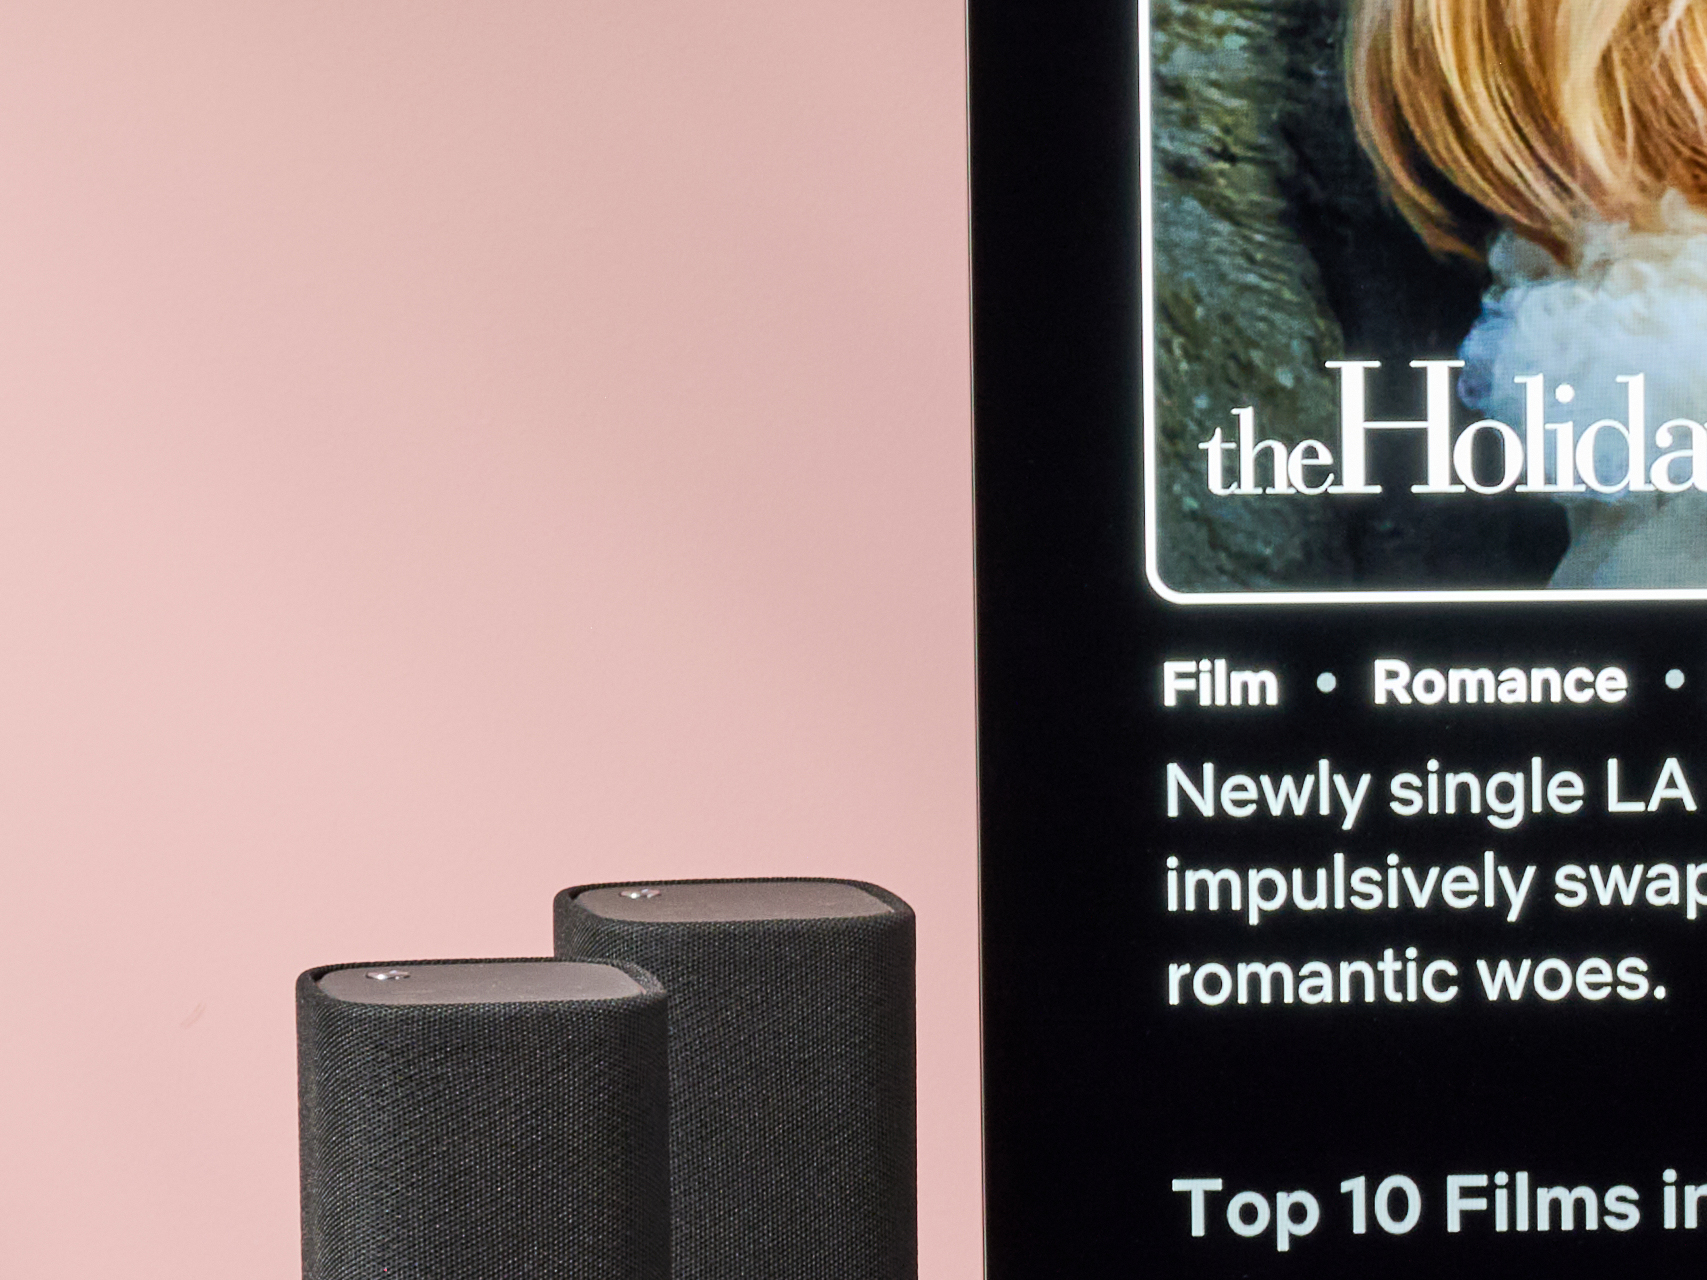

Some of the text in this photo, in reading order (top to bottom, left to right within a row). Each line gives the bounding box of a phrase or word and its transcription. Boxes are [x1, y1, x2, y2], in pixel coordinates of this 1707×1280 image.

[1199, 406, 1336, 495] the
[1163, 660, 1279, 706] Film
[1374, 658, 1628, 704] Romance
[1166, 760, 1371, 830] Newly
[1389, 757, 1585, 828] single
[1607, 757, 1697, 814] LA
[1166, 849, 1536, 926] impulsively
[1167, 945, 1668, 1005] romantic woes.
[1171, 1177, 1322, 1252] Top
[1338, 1175, 1421, 1235] 10
[1446, 1171, 1641, 1233] Films
